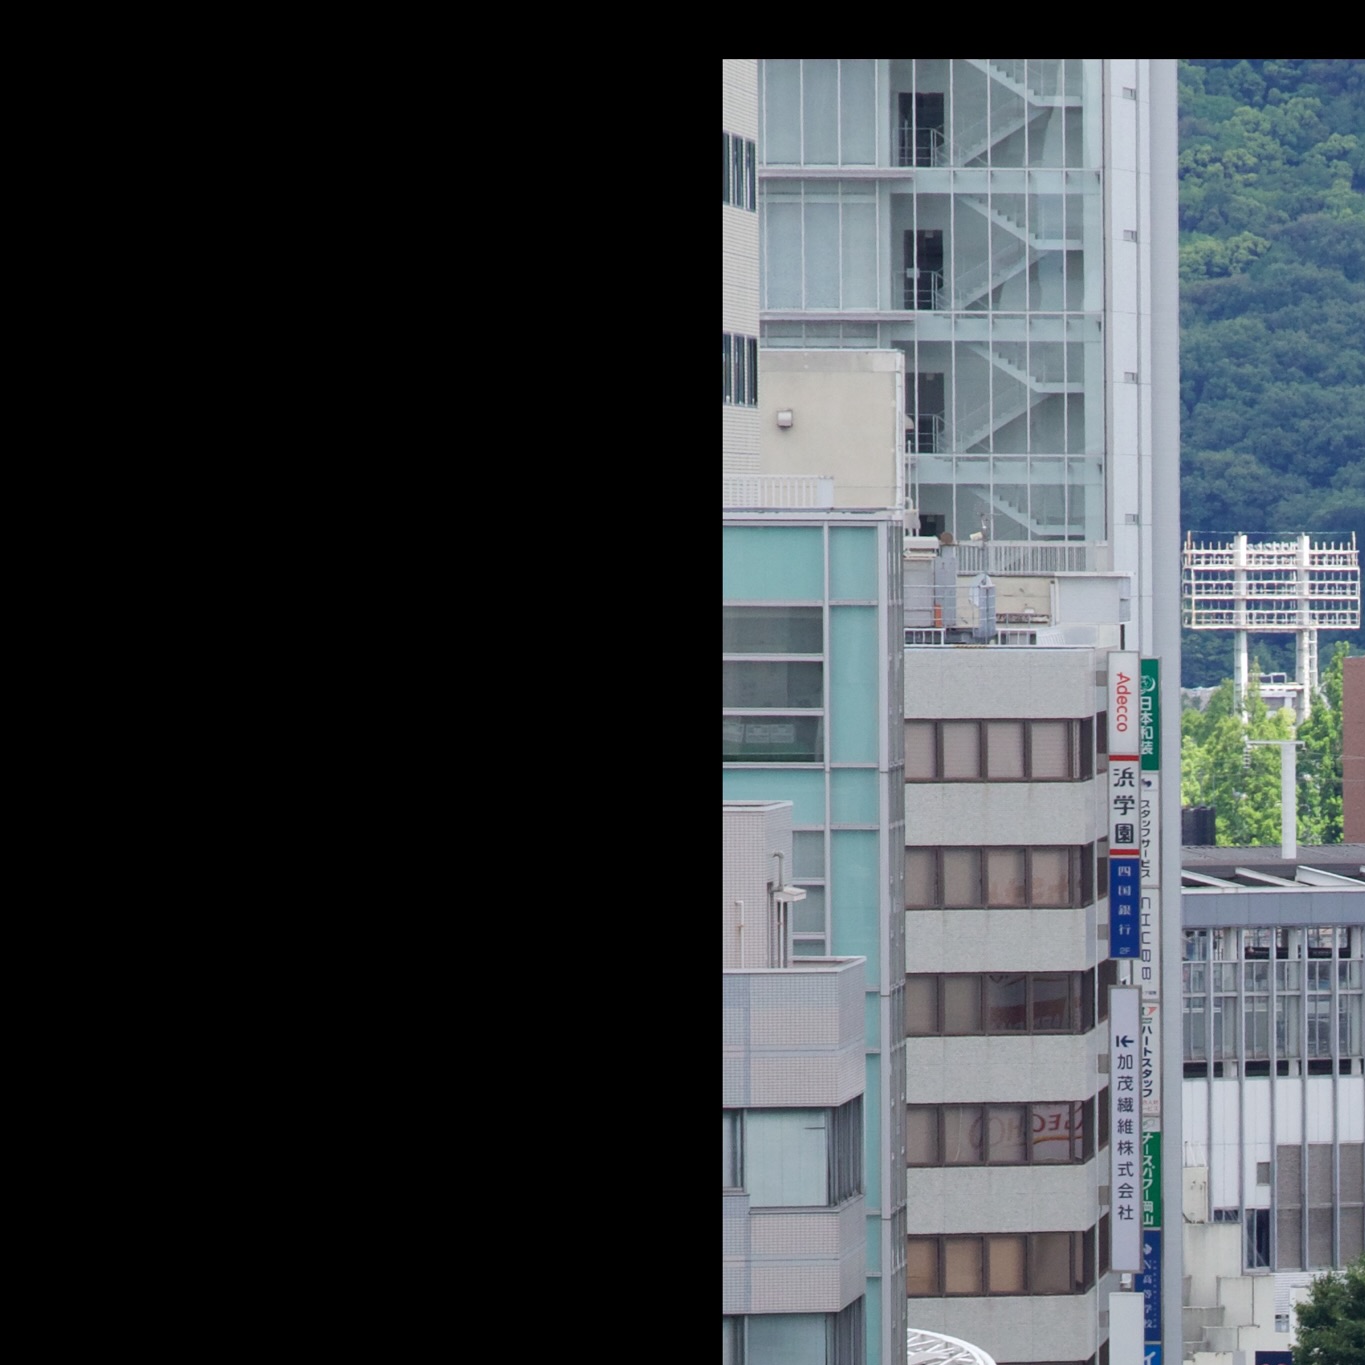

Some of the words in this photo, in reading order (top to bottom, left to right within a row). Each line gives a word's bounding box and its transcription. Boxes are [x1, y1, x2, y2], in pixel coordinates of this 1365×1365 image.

[1116, 672, 1131, 732] Adecco
[1113, 767, 1135, 844] 浜学園
[1118, 866, 1131, 936] 四国銀行
[1141, 1026, 1153, 1097] ハートスタッフ
[1117, 1054, 1134, 1220] 加茂繊維株式会社
